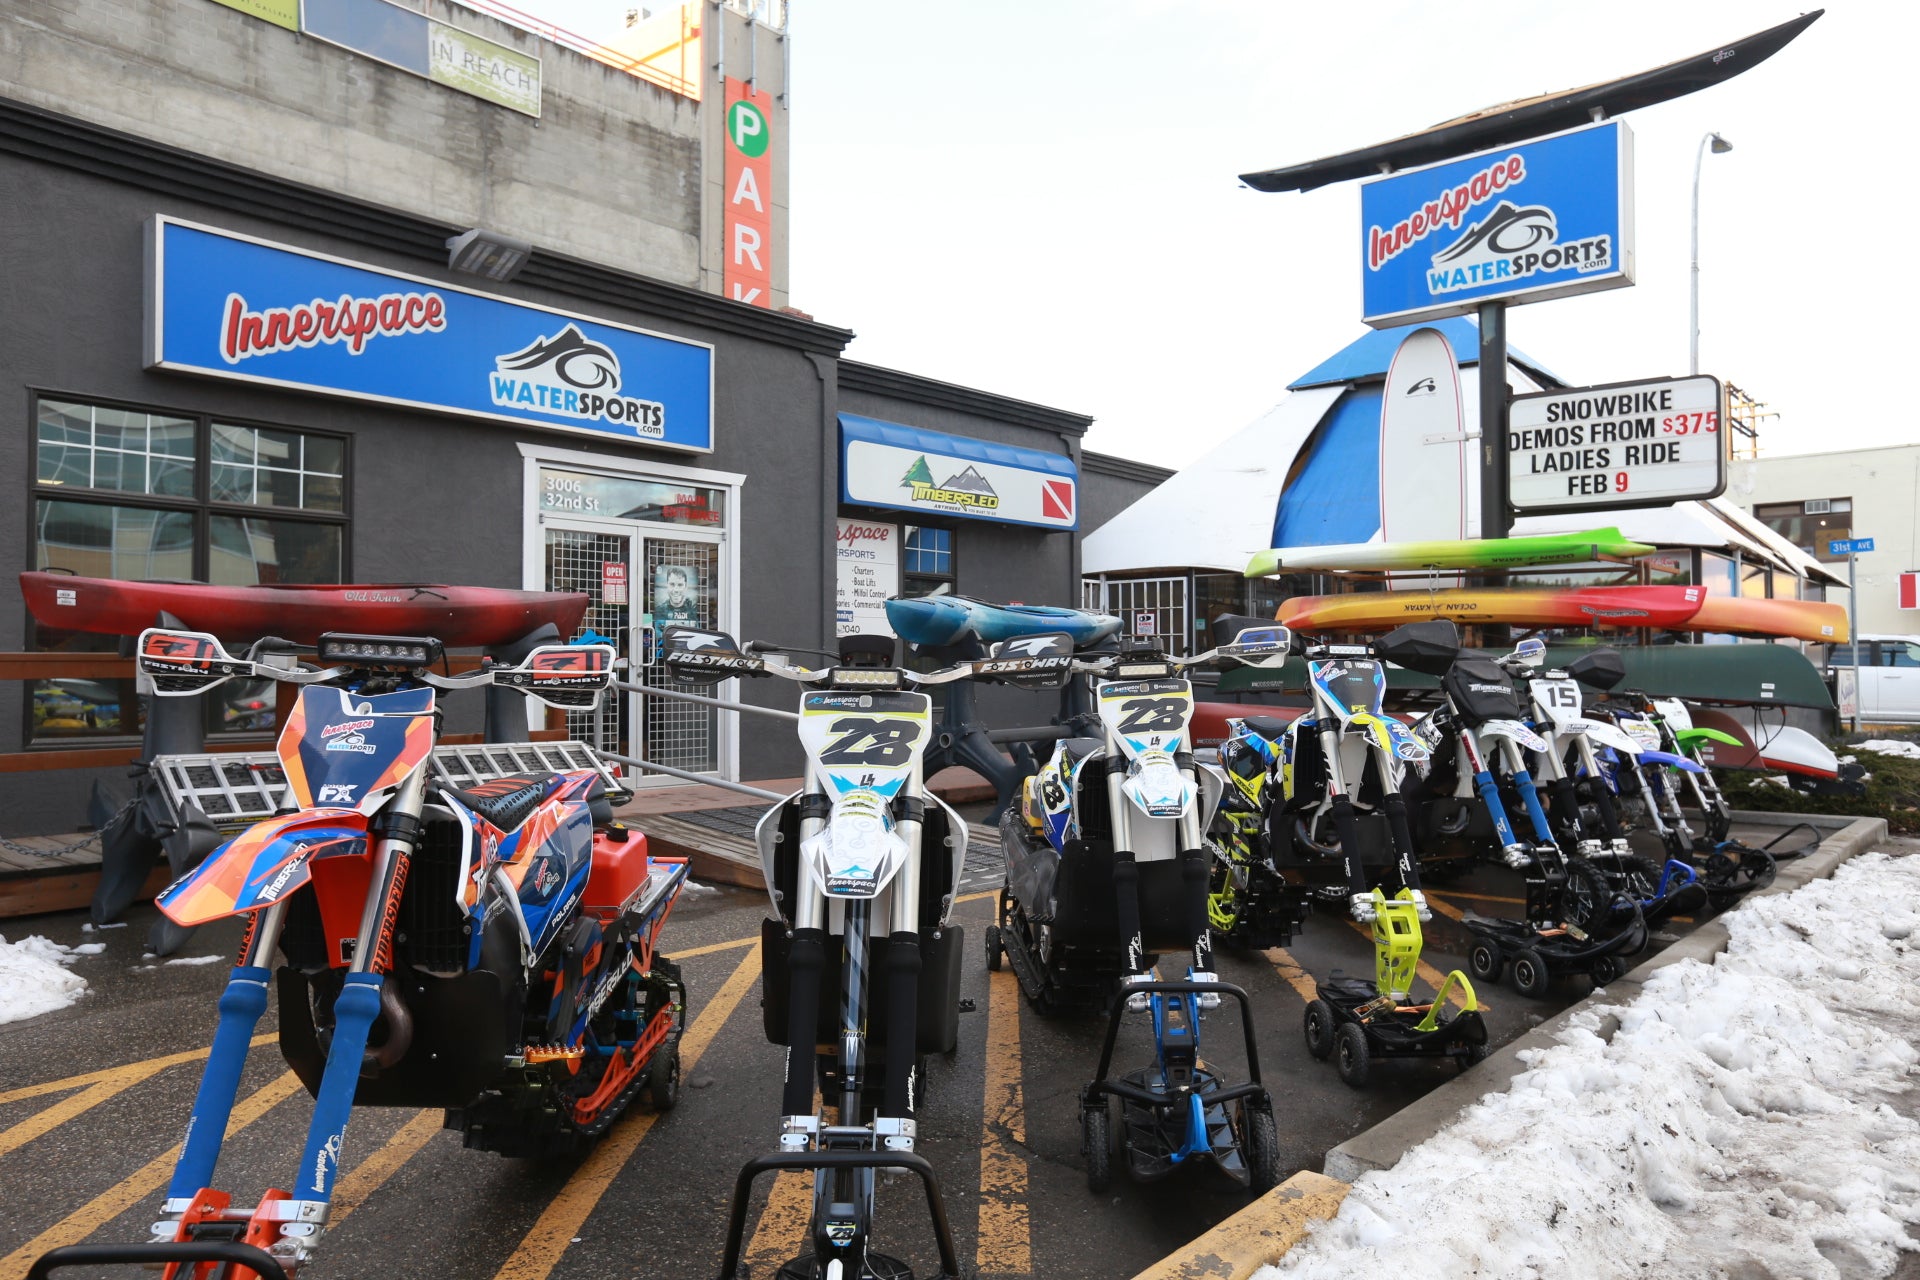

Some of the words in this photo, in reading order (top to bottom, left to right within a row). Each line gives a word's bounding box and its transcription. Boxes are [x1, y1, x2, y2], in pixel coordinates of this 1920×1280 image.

[431, 40, 453, 63] IN
[464, 51, 531, 91] REACH
[1371, 157, 1523, 267] Innerspace
[1429, 238, 1607, 291] WATERSPORTS
[224, 293, 445, 359] Innerspace
[494, 375, 662, 428] WATERSPORTS
[1546, 389, 1672, 423] SNOWBIKE
[1509, 425, 1584, 452] DEMOS
[1591, 418, 1655, 444] FROM
[1662, 411, 1719, 436] $375
[1531, 447, 1610, 474] LADIES
[1625, 441, 1681, 467] RIDE
[546, 477, 582, 494] 3006
[1568, 474, 1608, 496] FEB
[1615, 472, 1629, 493] 9
[546, 492, 582, 511] 32nd
[585, 497, 600, 511] St
[674, 492, 706, 507] MAIN
[661, 506, 720, 523] ENTRANCE
[1832, 542, 1851, 552] 31st
[1857, 541, 1872, 550] AVE
[606, 566, 624, 577] OPEN
[853, 566, 874, 576] Charters
[853, 577, 865, 587] Boat
[866, 578, 876, 587] Lifts
[1404, 604, 1431, 612] KAYAK
[1446, 603, 1477, 611] OCEAN
[533, 677, 600, 686] FATWAY
[1547, 687, 1577, 708] 15
[1117, 697, 1189, 735] 28
[321, 720, 374, 738] Innerspace
[819, 717, 923, 768] 28
[827, 878, 876, 888] Innerspace
[551, 893, 576, 928] POLARIS
